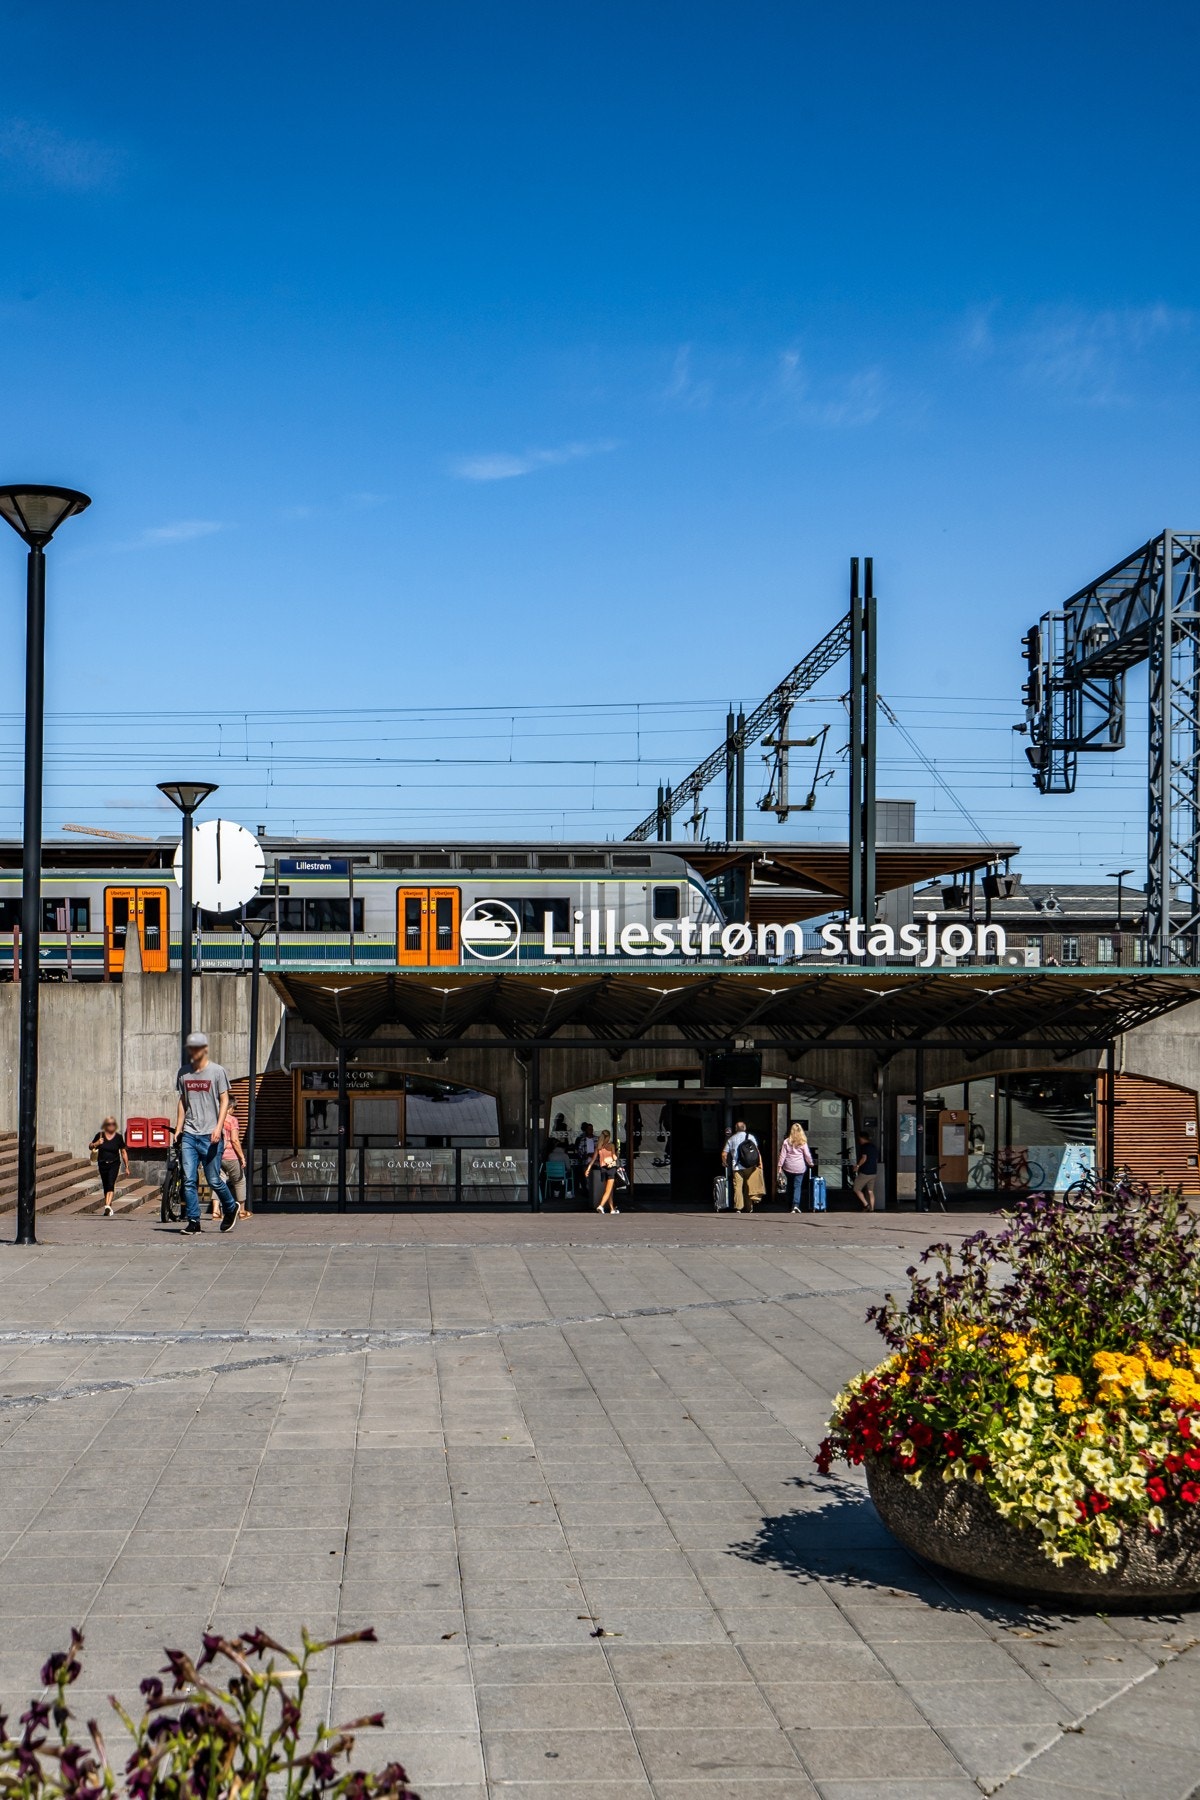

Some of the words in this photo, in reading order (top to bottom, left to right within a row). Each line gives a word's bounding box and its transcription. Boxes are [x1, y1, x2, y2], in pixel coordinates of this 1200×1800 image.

[295, 861, 332, 871] Lillestrøm
[543, 911, 804, 957] Lillestrøm
[821, 913, 1006, 967] stasjon
[328, 1071, 375, 1081] GRÇON
[291, 1160, 336, 1169] GARÇON
[387, 1160, 432, 1169] GARÇON
[472, 1160, 517, 1169] GARÇON
